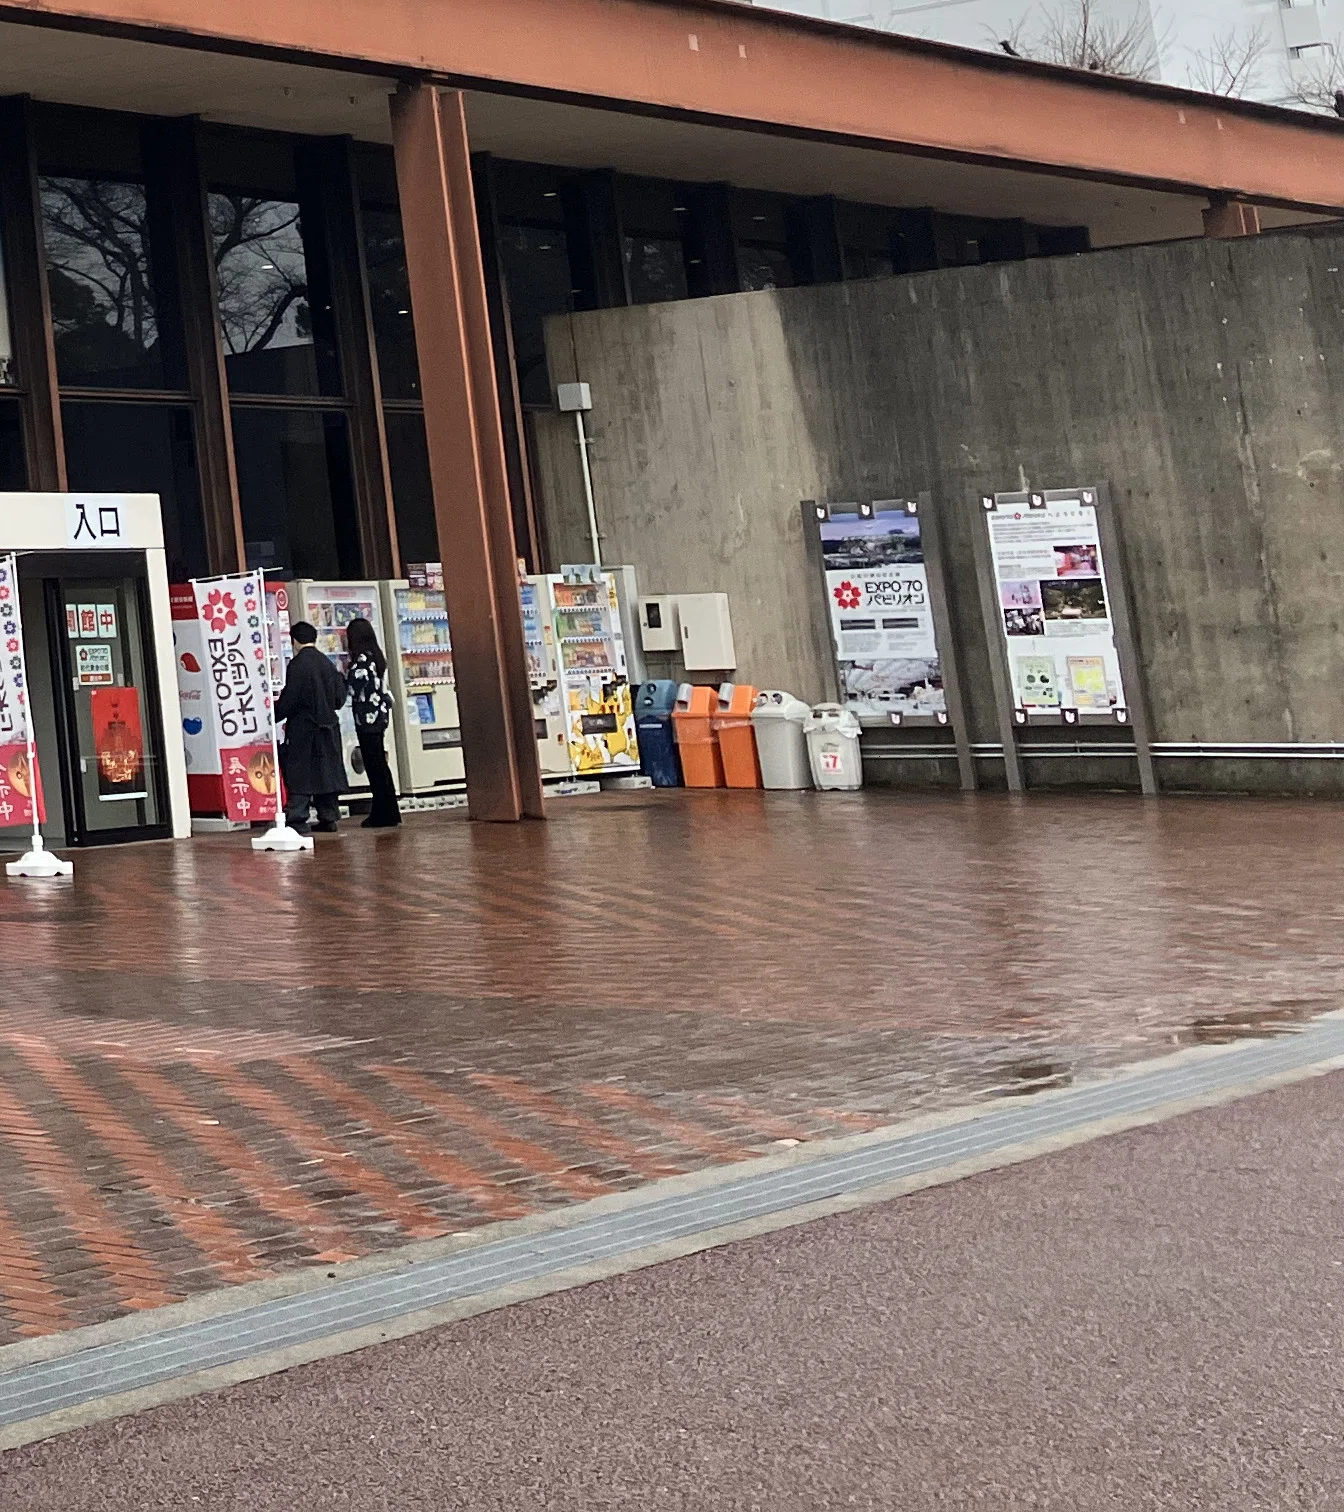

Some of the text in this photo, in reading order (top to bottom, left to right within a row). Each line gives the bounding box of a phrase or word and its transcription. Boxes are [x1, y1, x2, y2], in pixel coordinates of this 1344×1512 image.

[73, 503, 120, 539] 入口
[867, 593, 925, 606] パビリオン
